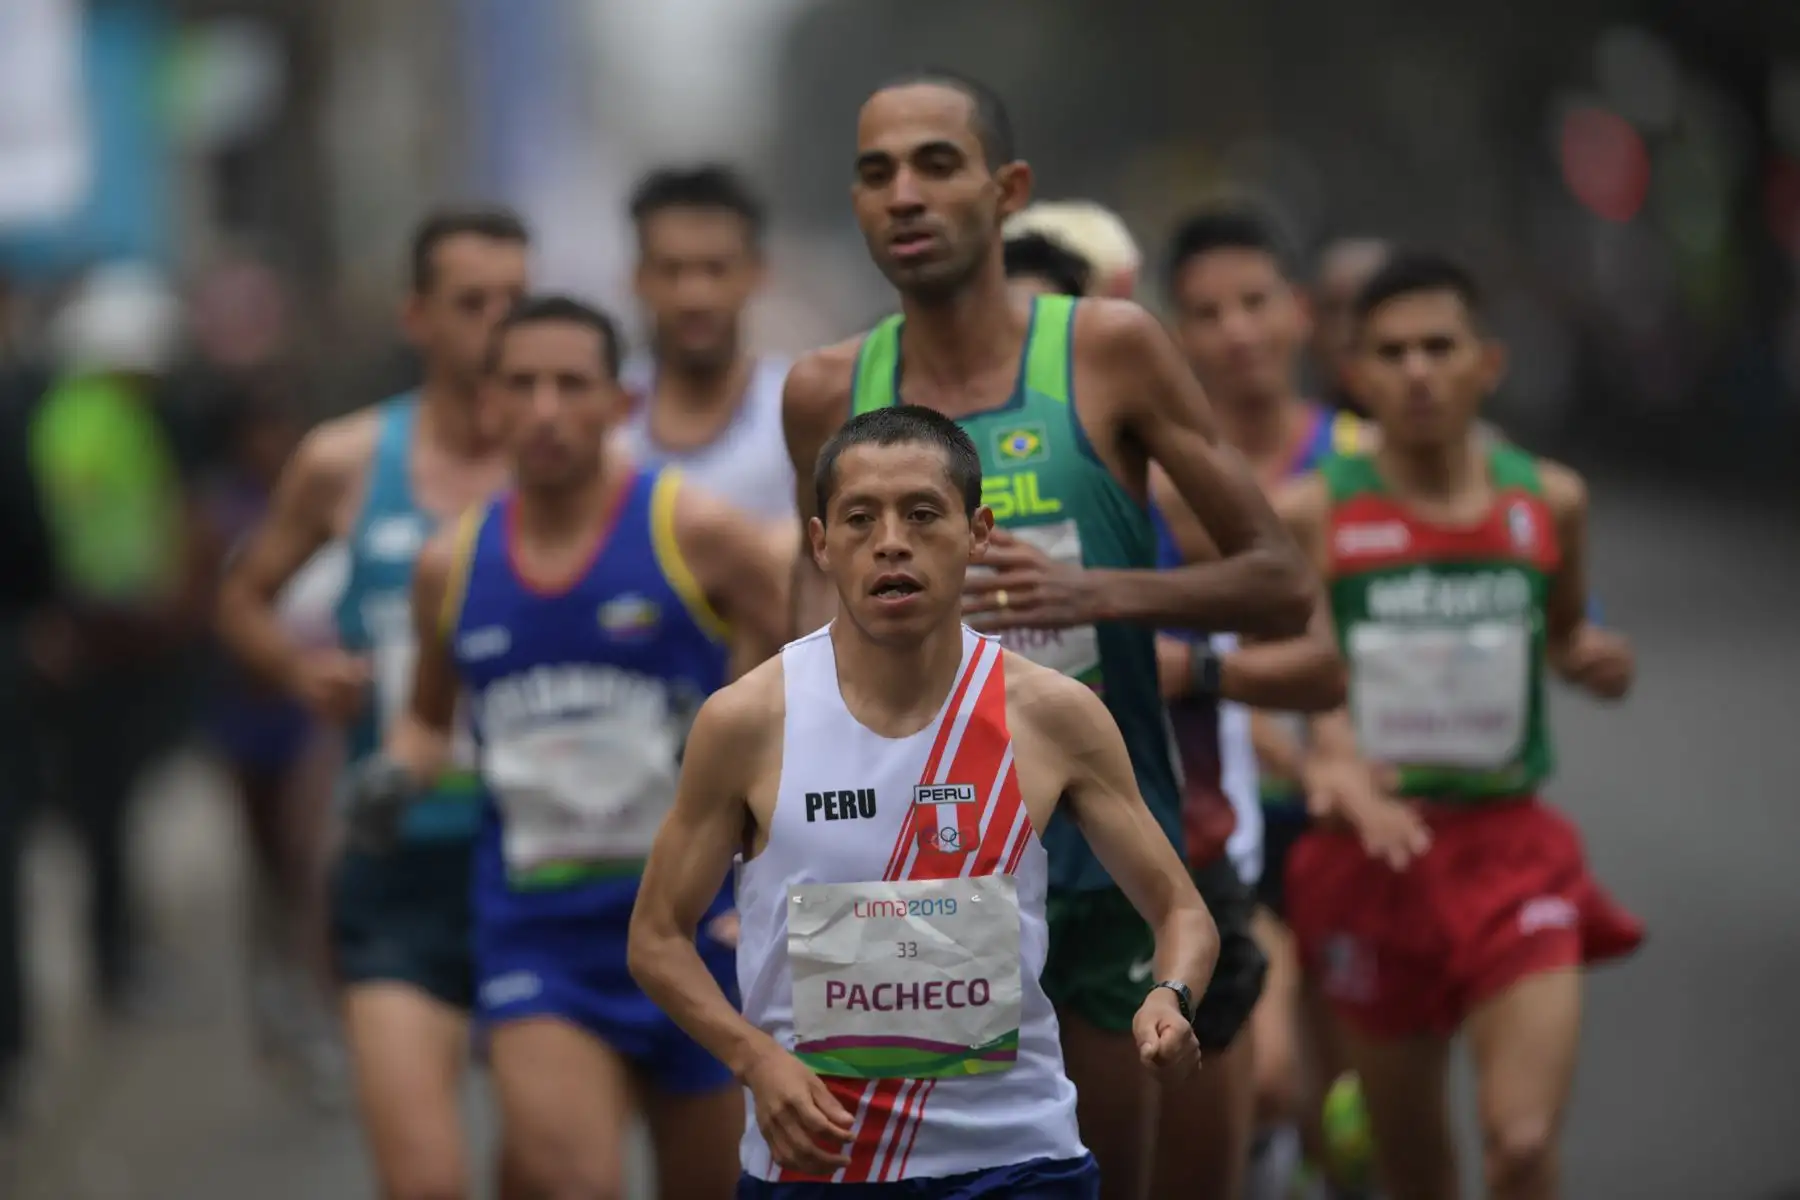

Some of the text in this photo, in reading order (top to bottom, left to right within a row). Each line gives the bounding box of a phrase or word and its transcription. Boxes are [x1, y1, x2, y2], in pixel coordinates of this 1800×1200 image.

[805, 788, 877, 822] PERU
[918, 787, 972, 802] PERU
[896, 941, 918, 959] 33
[826, 977, 991, 1012] PACHECO
